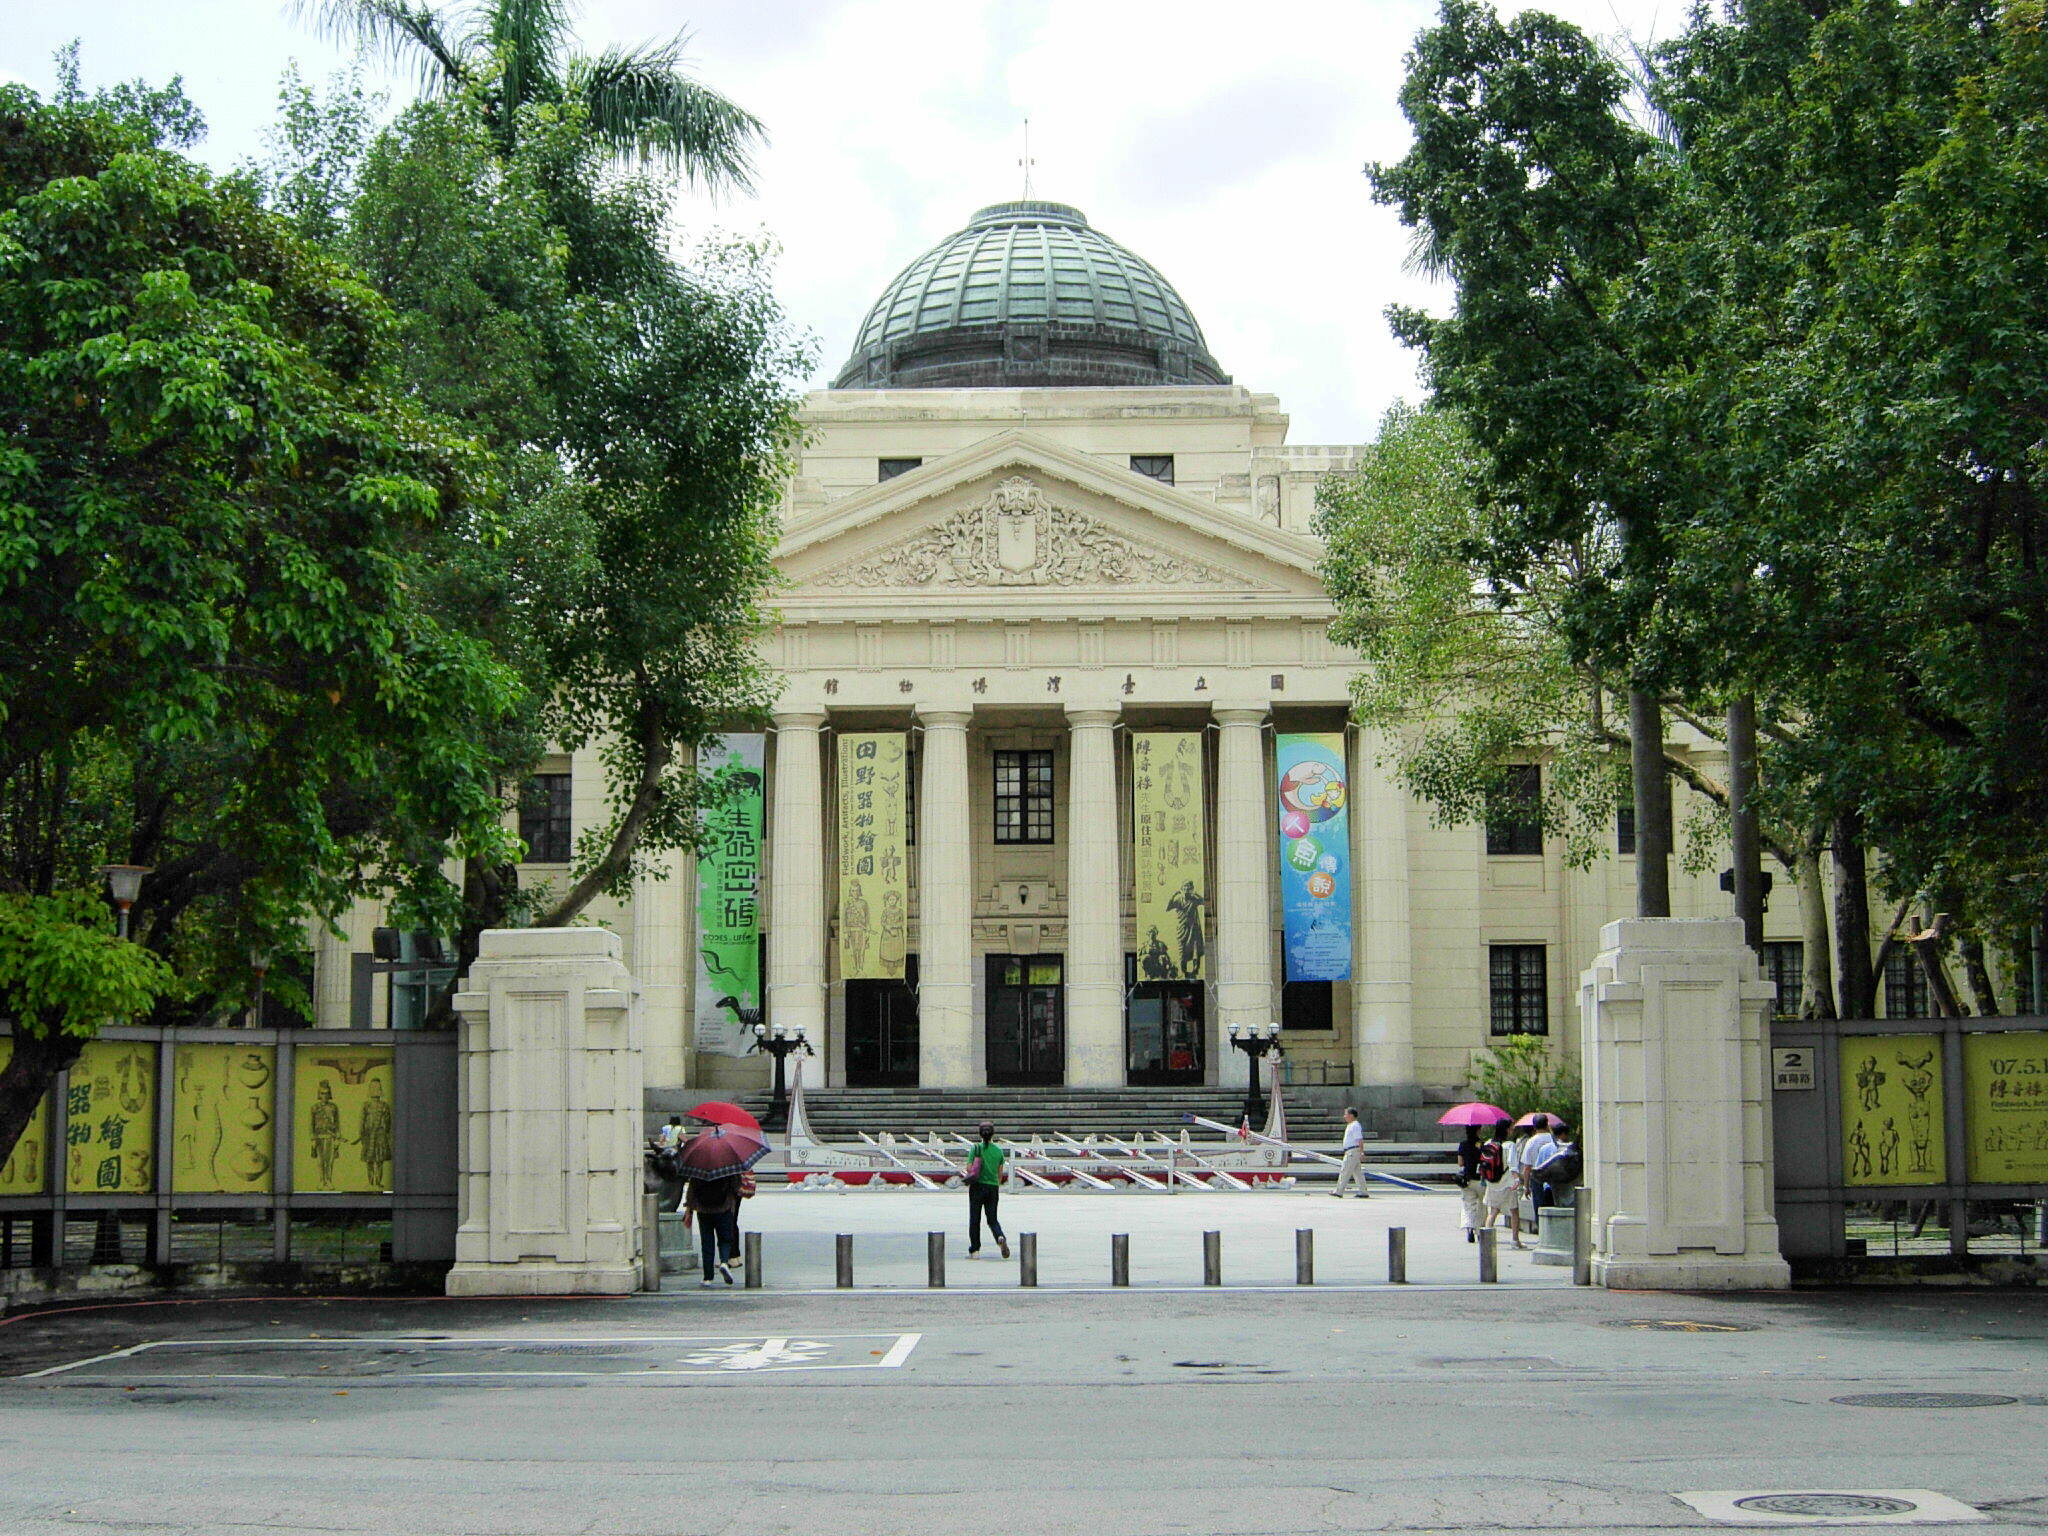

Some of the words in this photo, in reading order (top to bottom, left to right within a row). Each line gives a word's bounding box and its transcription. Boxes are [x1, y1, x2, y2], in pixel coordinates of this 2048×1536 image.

[854, 740, 878, 876] 田野器物繪圖
[1784, 1053, 1802, 1067] 2
[66, 1083, 92, 1146] 器物
[96, 1113, 129, 1189] 繪圖
